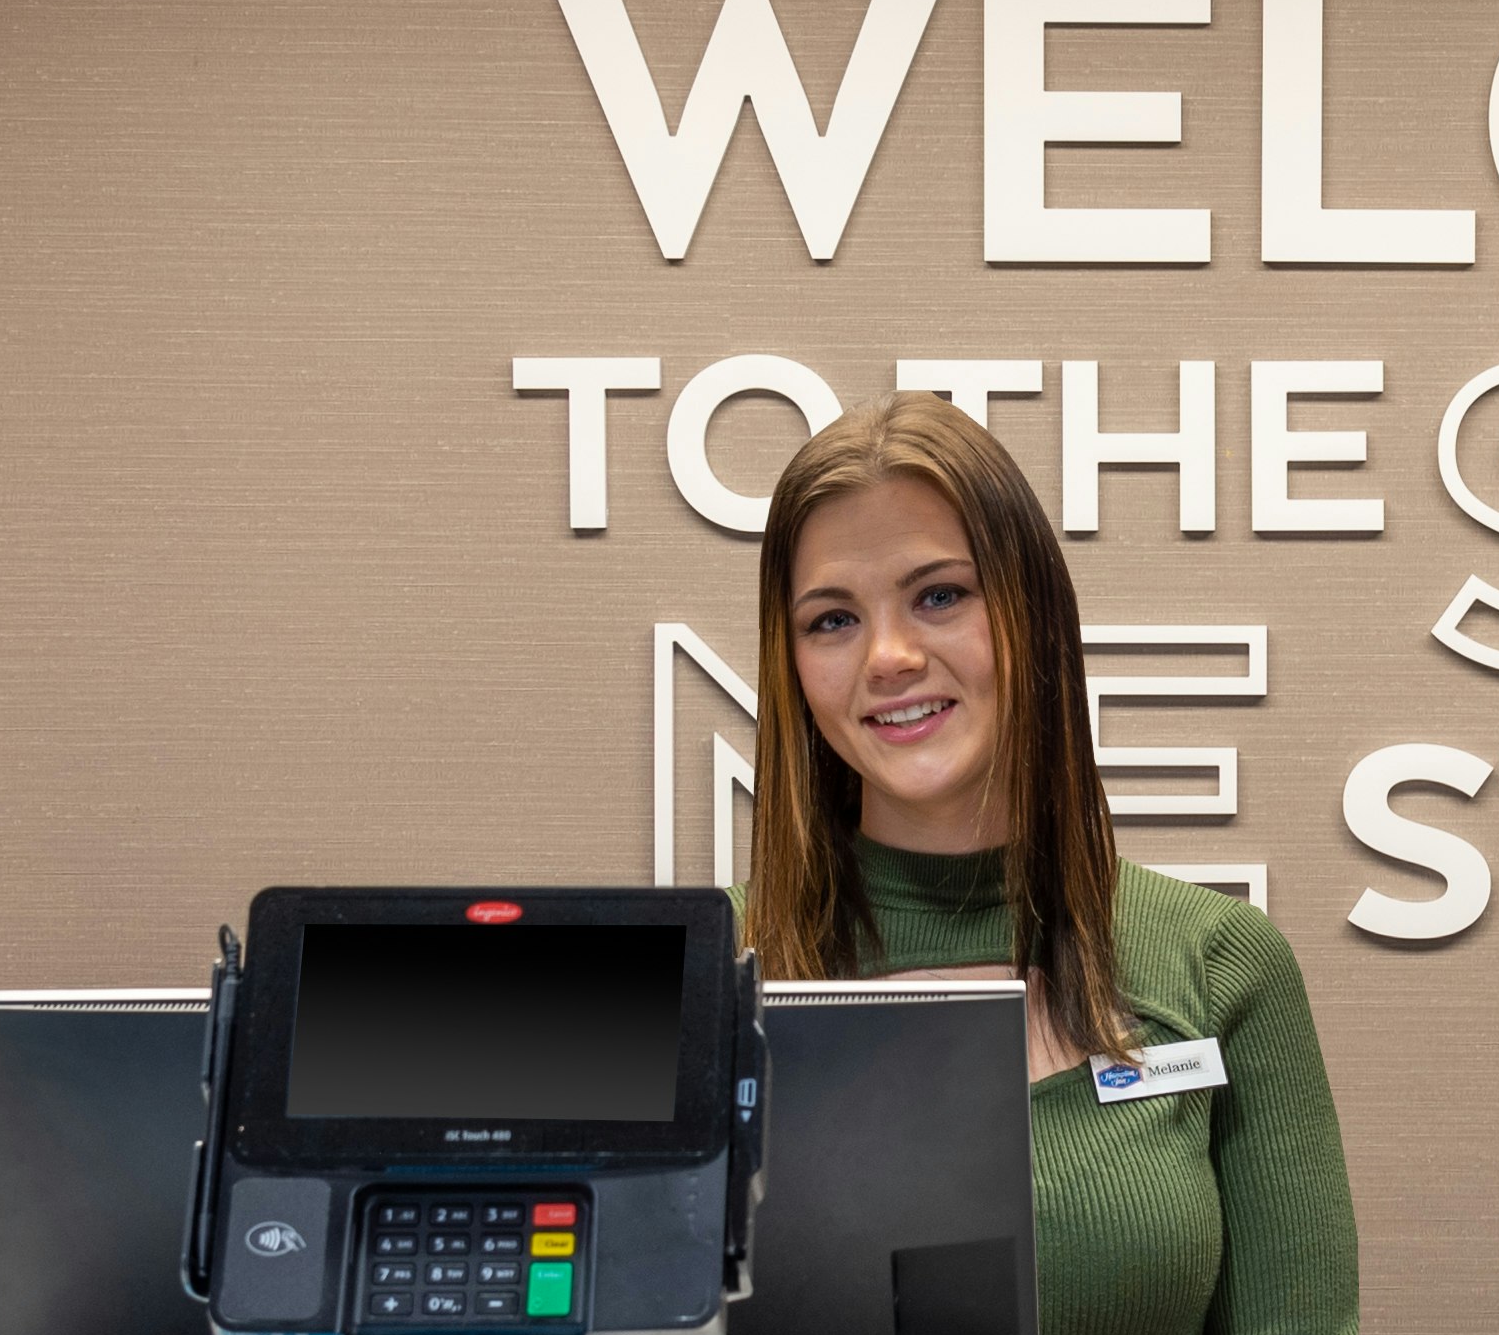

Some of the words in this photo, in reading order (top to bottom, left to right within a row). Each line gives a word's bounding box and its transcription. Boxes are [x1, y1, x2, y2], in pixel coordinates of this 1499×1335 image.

[512, 354, 844, 533] TO
[896, 358, 1384, 532] THE
[1147, 1059, 1202, 1077] Melanie
[385, 1208, 394, 1222] 1
[436, 1208, 447, 1222] 2
[487, 1208, 498, 1222] 3
[381, 1238, 391, 1251] 4
[434, 1237, 444, 1251] 5
[484, 1237, 495, 1251] 6
[379, 1267, 390, 1281] 7
[431, 1267, 443, 1281] 8
[481, 1267, 493, 1281] 9
